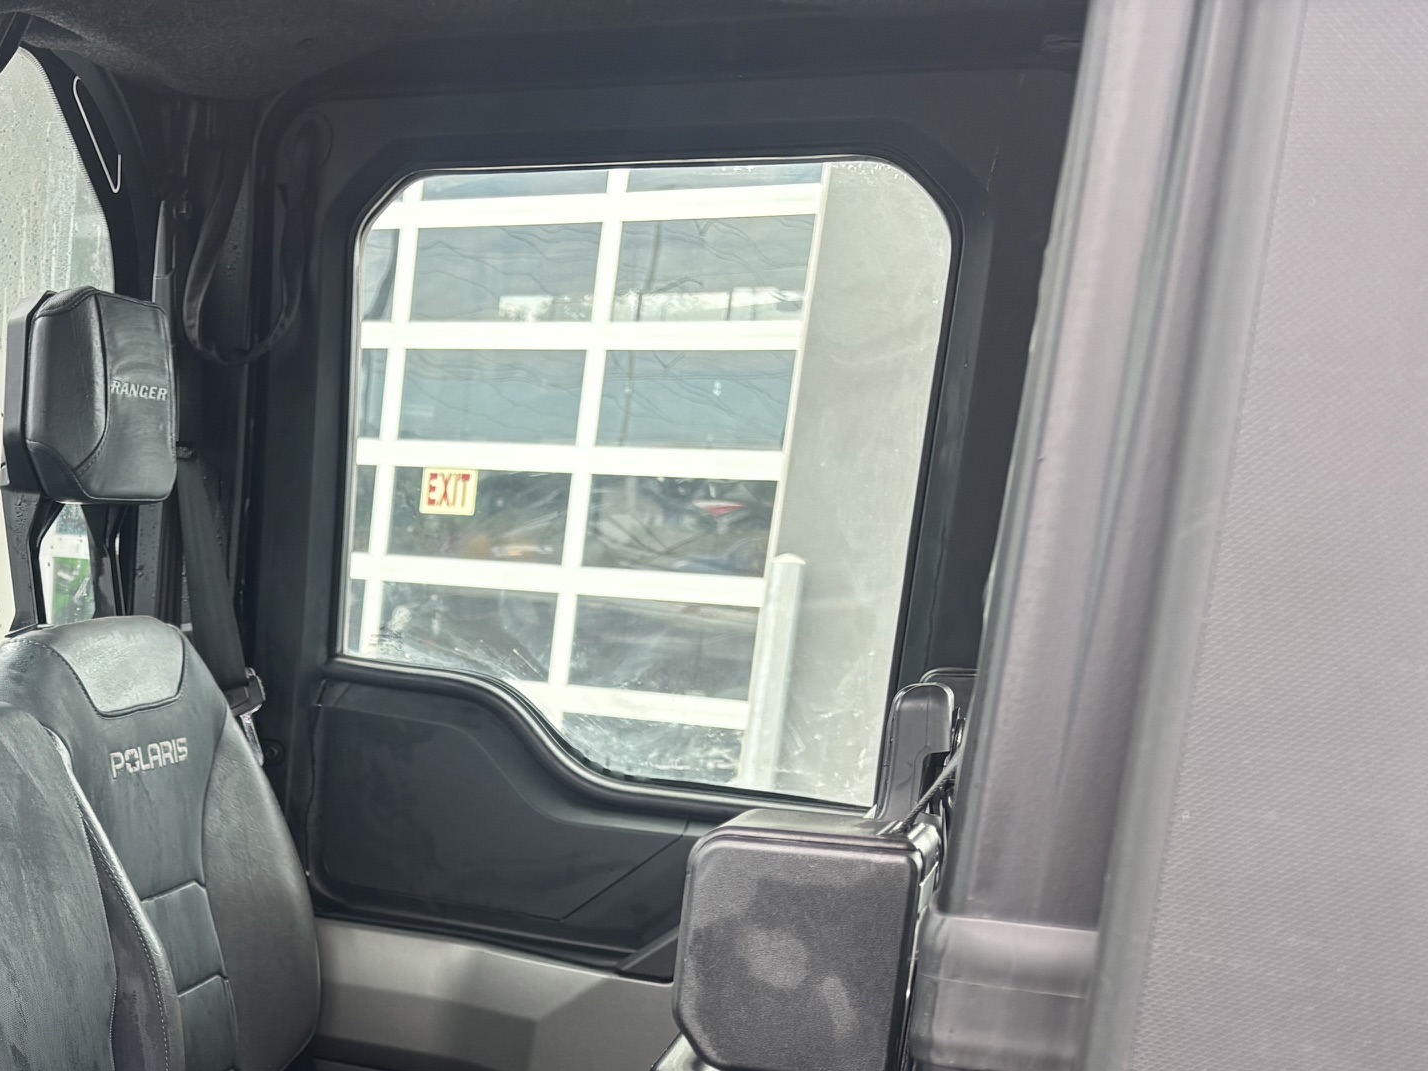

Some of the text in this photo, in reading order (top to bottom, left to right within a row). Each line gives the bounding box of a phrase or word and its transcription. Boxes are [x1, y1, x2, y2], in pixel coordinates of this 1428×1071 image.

[111, 380, 168, 401] RANGER
[427, 472, 471, 508] EXIT
[109, 737, 189, 779] POLARIS
